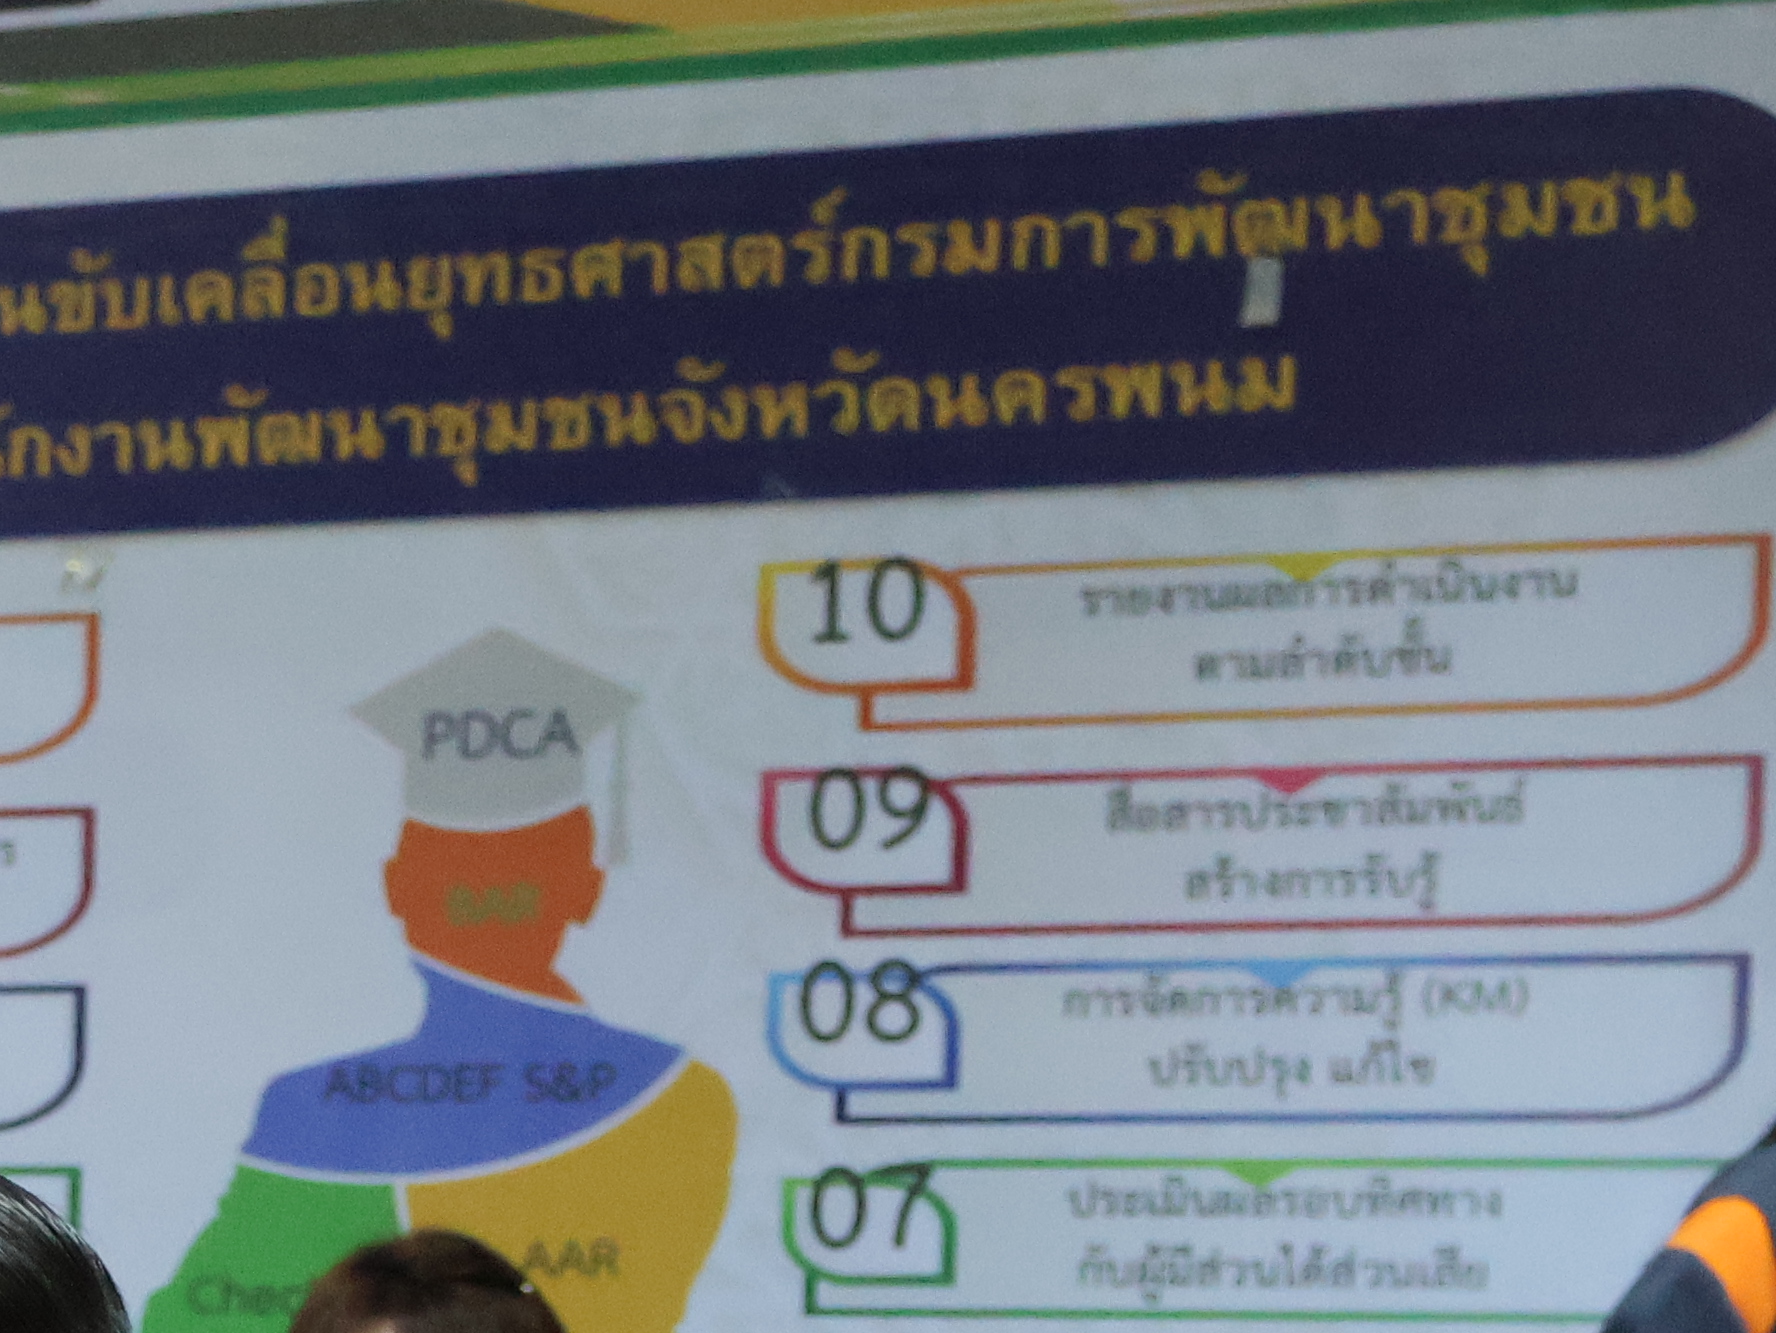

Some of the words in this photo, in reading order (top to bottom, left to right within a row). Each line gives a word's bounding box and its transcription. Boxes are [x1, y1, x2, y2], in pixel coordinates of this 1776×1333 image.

[812, 557, 927, 643] 10
[421, 707, 583, 762] PDCA
[810, 766, 929, 852] 09
[800, 959, 920, 1042] 08
[323, 1060, 505, 1107] ABCDEF
[812, 1163, 931, 1248] 07
[520, 1239, 622, 1281] AAR
[186, 1271, 304, 1320] Chec
